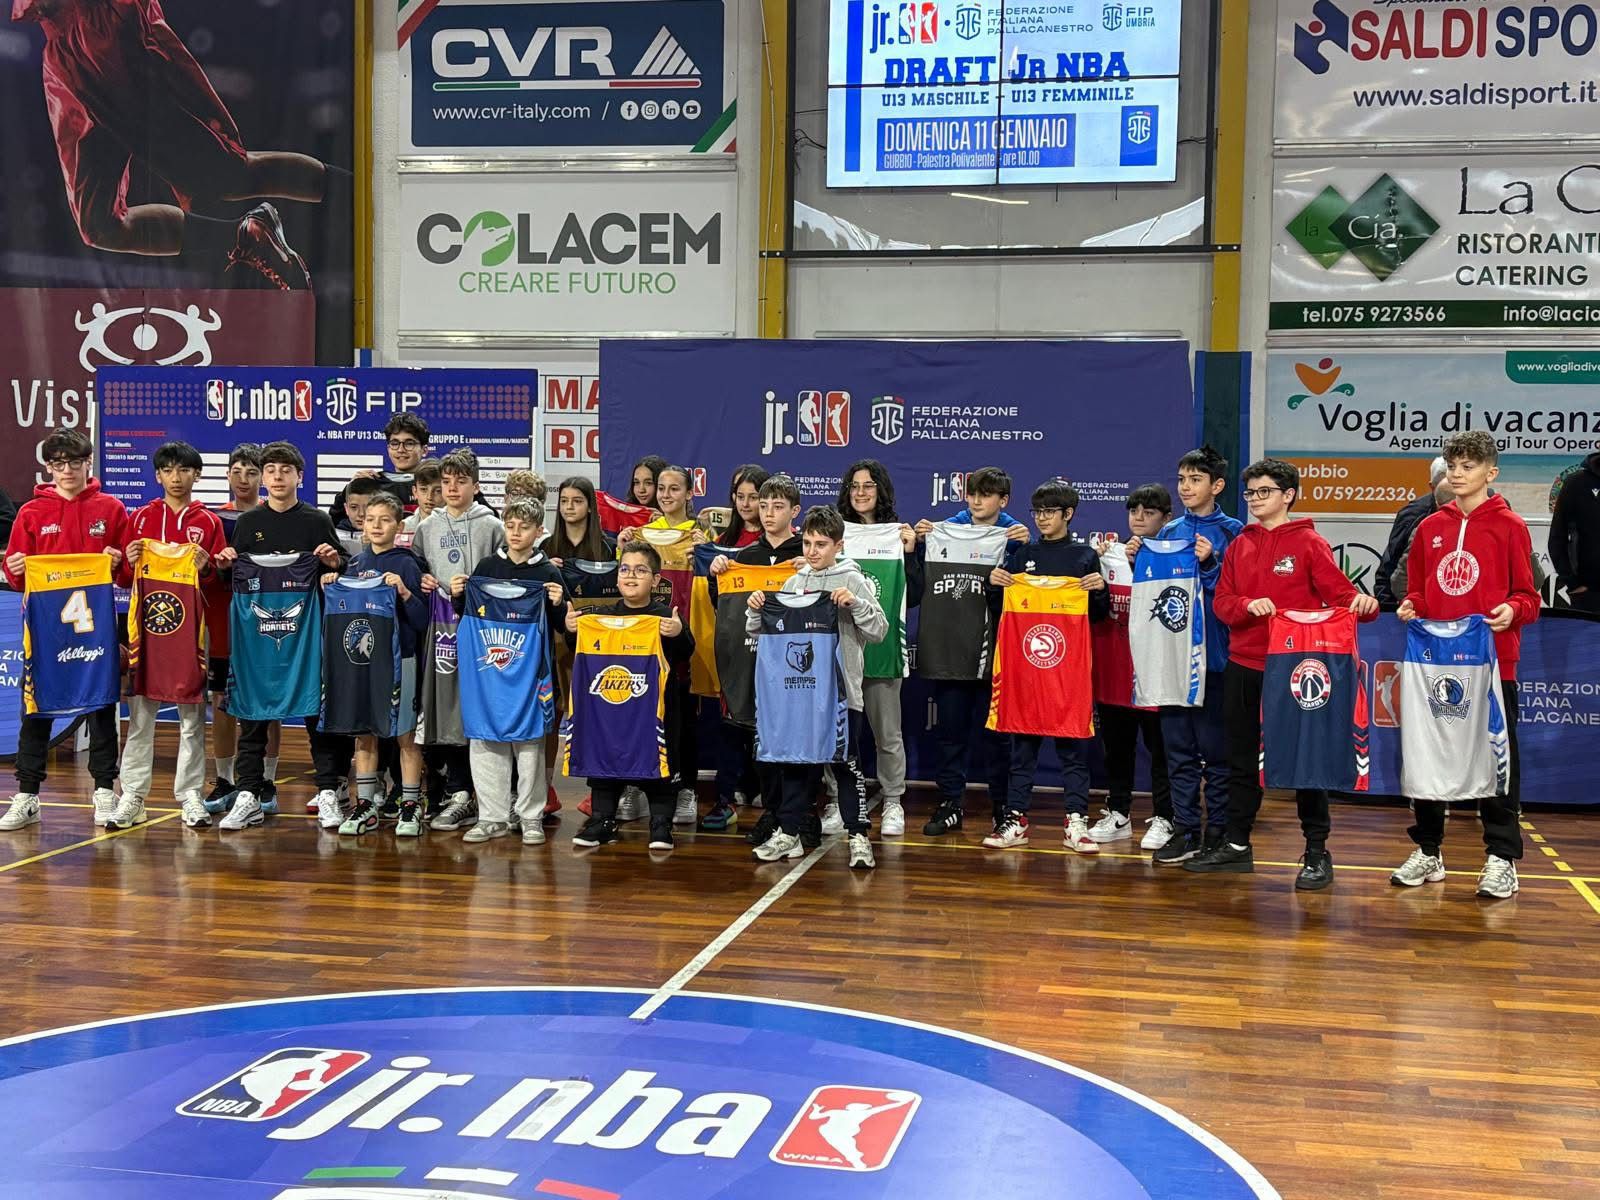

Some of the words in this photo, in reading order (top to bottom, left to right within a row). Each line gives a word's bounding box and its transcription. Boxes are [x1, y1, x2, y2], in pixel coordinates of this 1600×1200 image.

[987, 5, 1074, 17] FEDERAZIONE
[1126, 7, 1154, 17] FIP
[987, 15, 1044, 27] ITALIANA
[1125, 16, 1156, 28] UMBRIA
[987, 23, 1094, 36] PALLACANESTRO
[431, 26, 616, 78] CVR
[885, 55, 997, 88] DRAFT
[1056, 51, 1130, 82] NBA
[882, 93, 906, 107] U13
[911, 91, 989, 106] MASCHILE
[1011, 89, 1036, 103] U13
[1042, 87, 1134, 103] FEMMINILE
[1353, 81, 1598, 110] www.saldisport.it
[432, 103, 591, 121] www.cvr-italy.com
[883, 121, 971, 152] DOMENICA
[974, 120, 988, 150] 11
[991, 118, 1067, 150] GENNAIO
[884, 156, 912, 169] GUBBIO
[917, 154, 950, 168] Palestra
[950, 152, 995, 168] Polivalente
[1003, 152, 1016, 166] ore
[1017, 150, 1040, 166] 10.00
[1458, 167, 1535, 215] La
[417, 211, 722, 267] COLACEM
[1455, 265, 1588, 286] CATERING
[459, 271, 560, 294] CREARE
[568, 271, 677, 294] FUTURO
[1303, 306, 1364, 323] tel.075
[1371, 306, 1446, 322] 9273566
[366, 392, 422, 412] FIP
[912, 407, 1018, 417] FEDERAZIONE
[762, 391, 793, 454] jr.
[911, 418, 980, 428] ITALIANA
[1318, 402, 1428, 441] Voglia
[1440, 402, 1472, 433] di
[327, 430, 343, 440] NBA
[344, 431, 356, 440] FIP
[357, 431, 372, 440] U13
[428, 434, 459, 444] GRUPPO
[911, 430, 1043, 441] PALLACANESTRO
[1515, 436, 1549, 450] Tour
[1298, 464, 1348, 479] ubbio
[795, 477, 843, 485] FEDERAZION
[1071, 482, 1129, 490] FEDERAZIONE
[931, 473, 949, 507] jr.
[1312, 486, 1416, 501] 0759222326
[711, 512, 723, 524] 15
[941, 547, 948, 559] 4
[142, 563, 150, 575] 4
[1108, 569, 1115, 581] 6
[1145, 566, 1153, 578] 4
[733, 576, 745, 589] 13
[956, 573, 985, 582] ANTONIO
[338, 599, 346, 610] 4
[1021, 598, 1029, 609] 4
[61, 590, 94, 634] 4
[477, 604, 486, 617] 4
[260, 622, 296, 632] HORNETS
[775, 618, 785, 631] 4
[479, 627, 526, 651] THUNDER
[593, 639, 601, 651] 4
[1285, 636, 1294, 649] 4
[57, 646, 105, 664] Kellogg's
[1423, 648, 1432, 661] 4
[592, 675, 643, 695] LAKERS
[192, 1098, 252, 1114] NBA
[782, 1152, 843, 1163] WNBA
